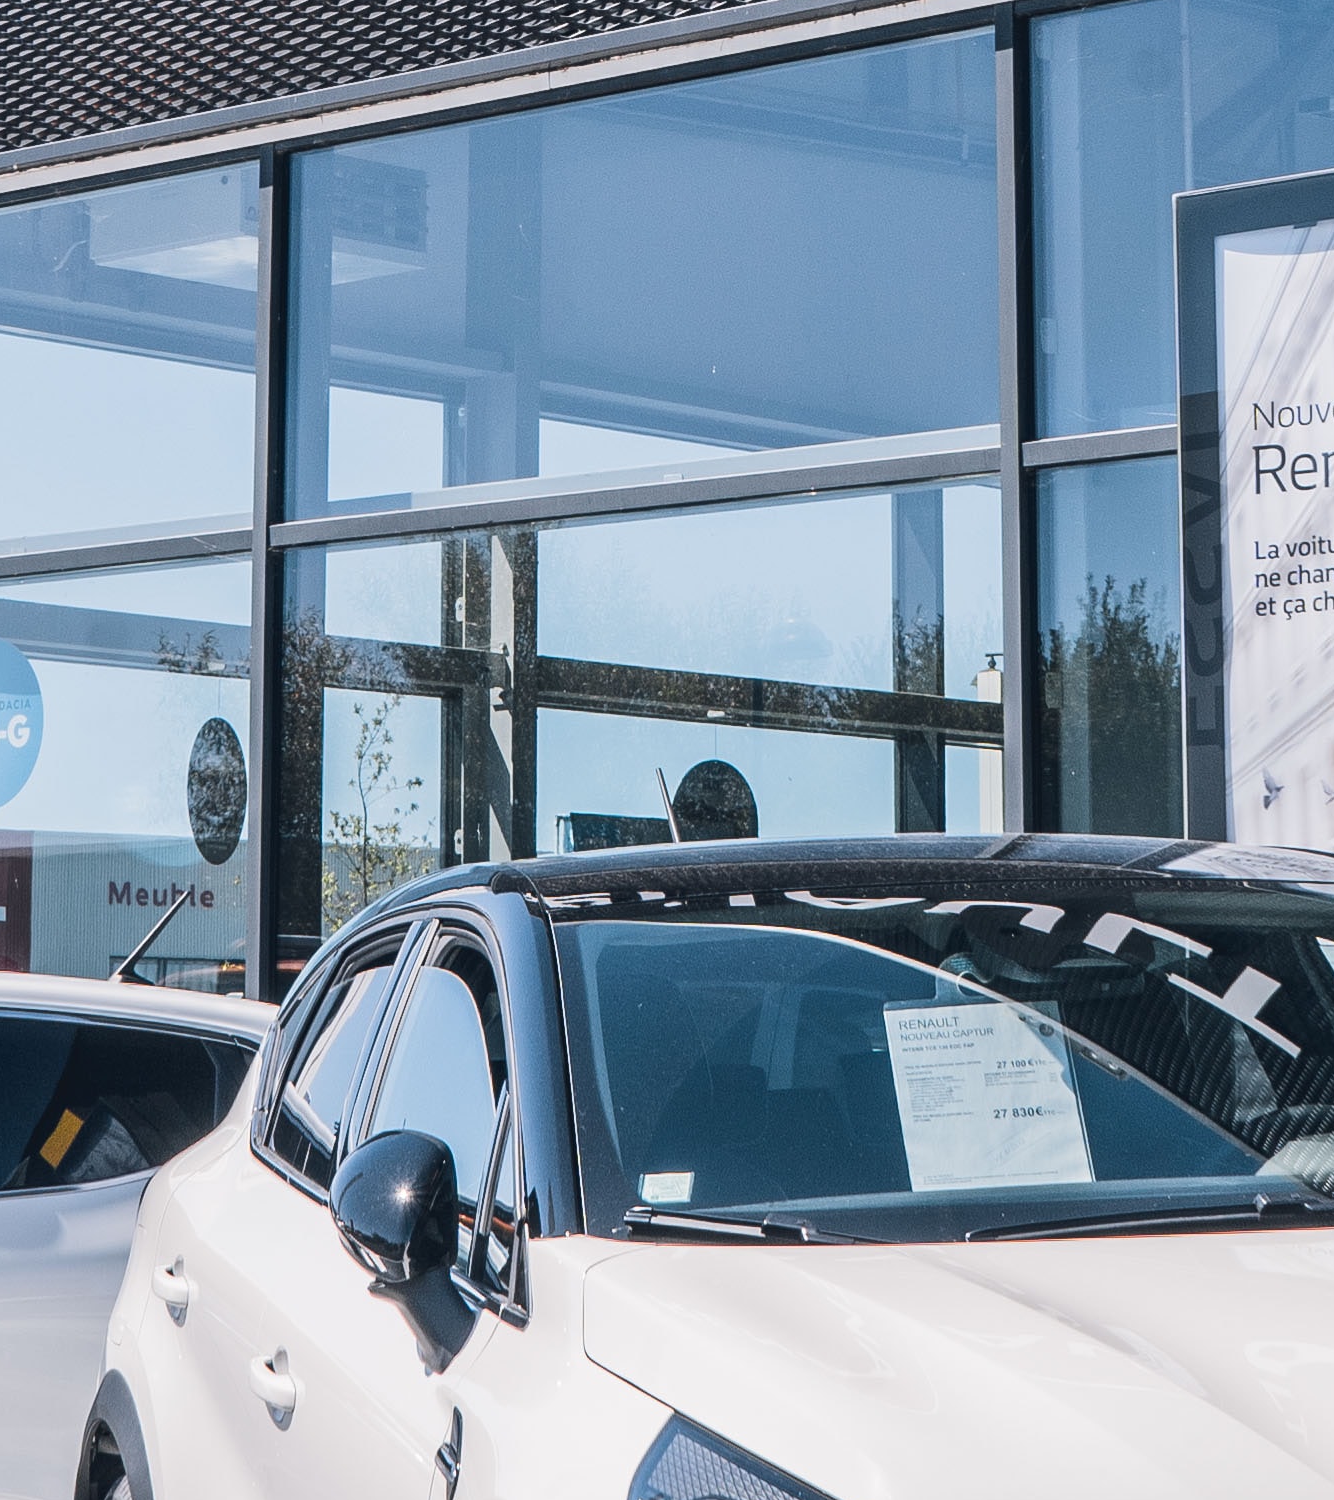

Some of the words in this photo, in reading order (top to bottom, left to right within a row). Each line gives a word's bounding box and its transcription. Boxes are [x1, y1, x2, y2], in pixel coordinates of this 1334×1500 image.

[1254, 540, 1280, 561] La
[1255, 568, 1282, 589] ne
[1254, 594, 1278, 617] et
[1282, 597, 1306, 622] ça
[898, 1016, 961, 1031] RENAULT
[900, 1030, 951, 1042] NOUVEAU
[952, 1027, 995, 1039] CAPTUR
[993, 1108, 1008, 1120] 27
